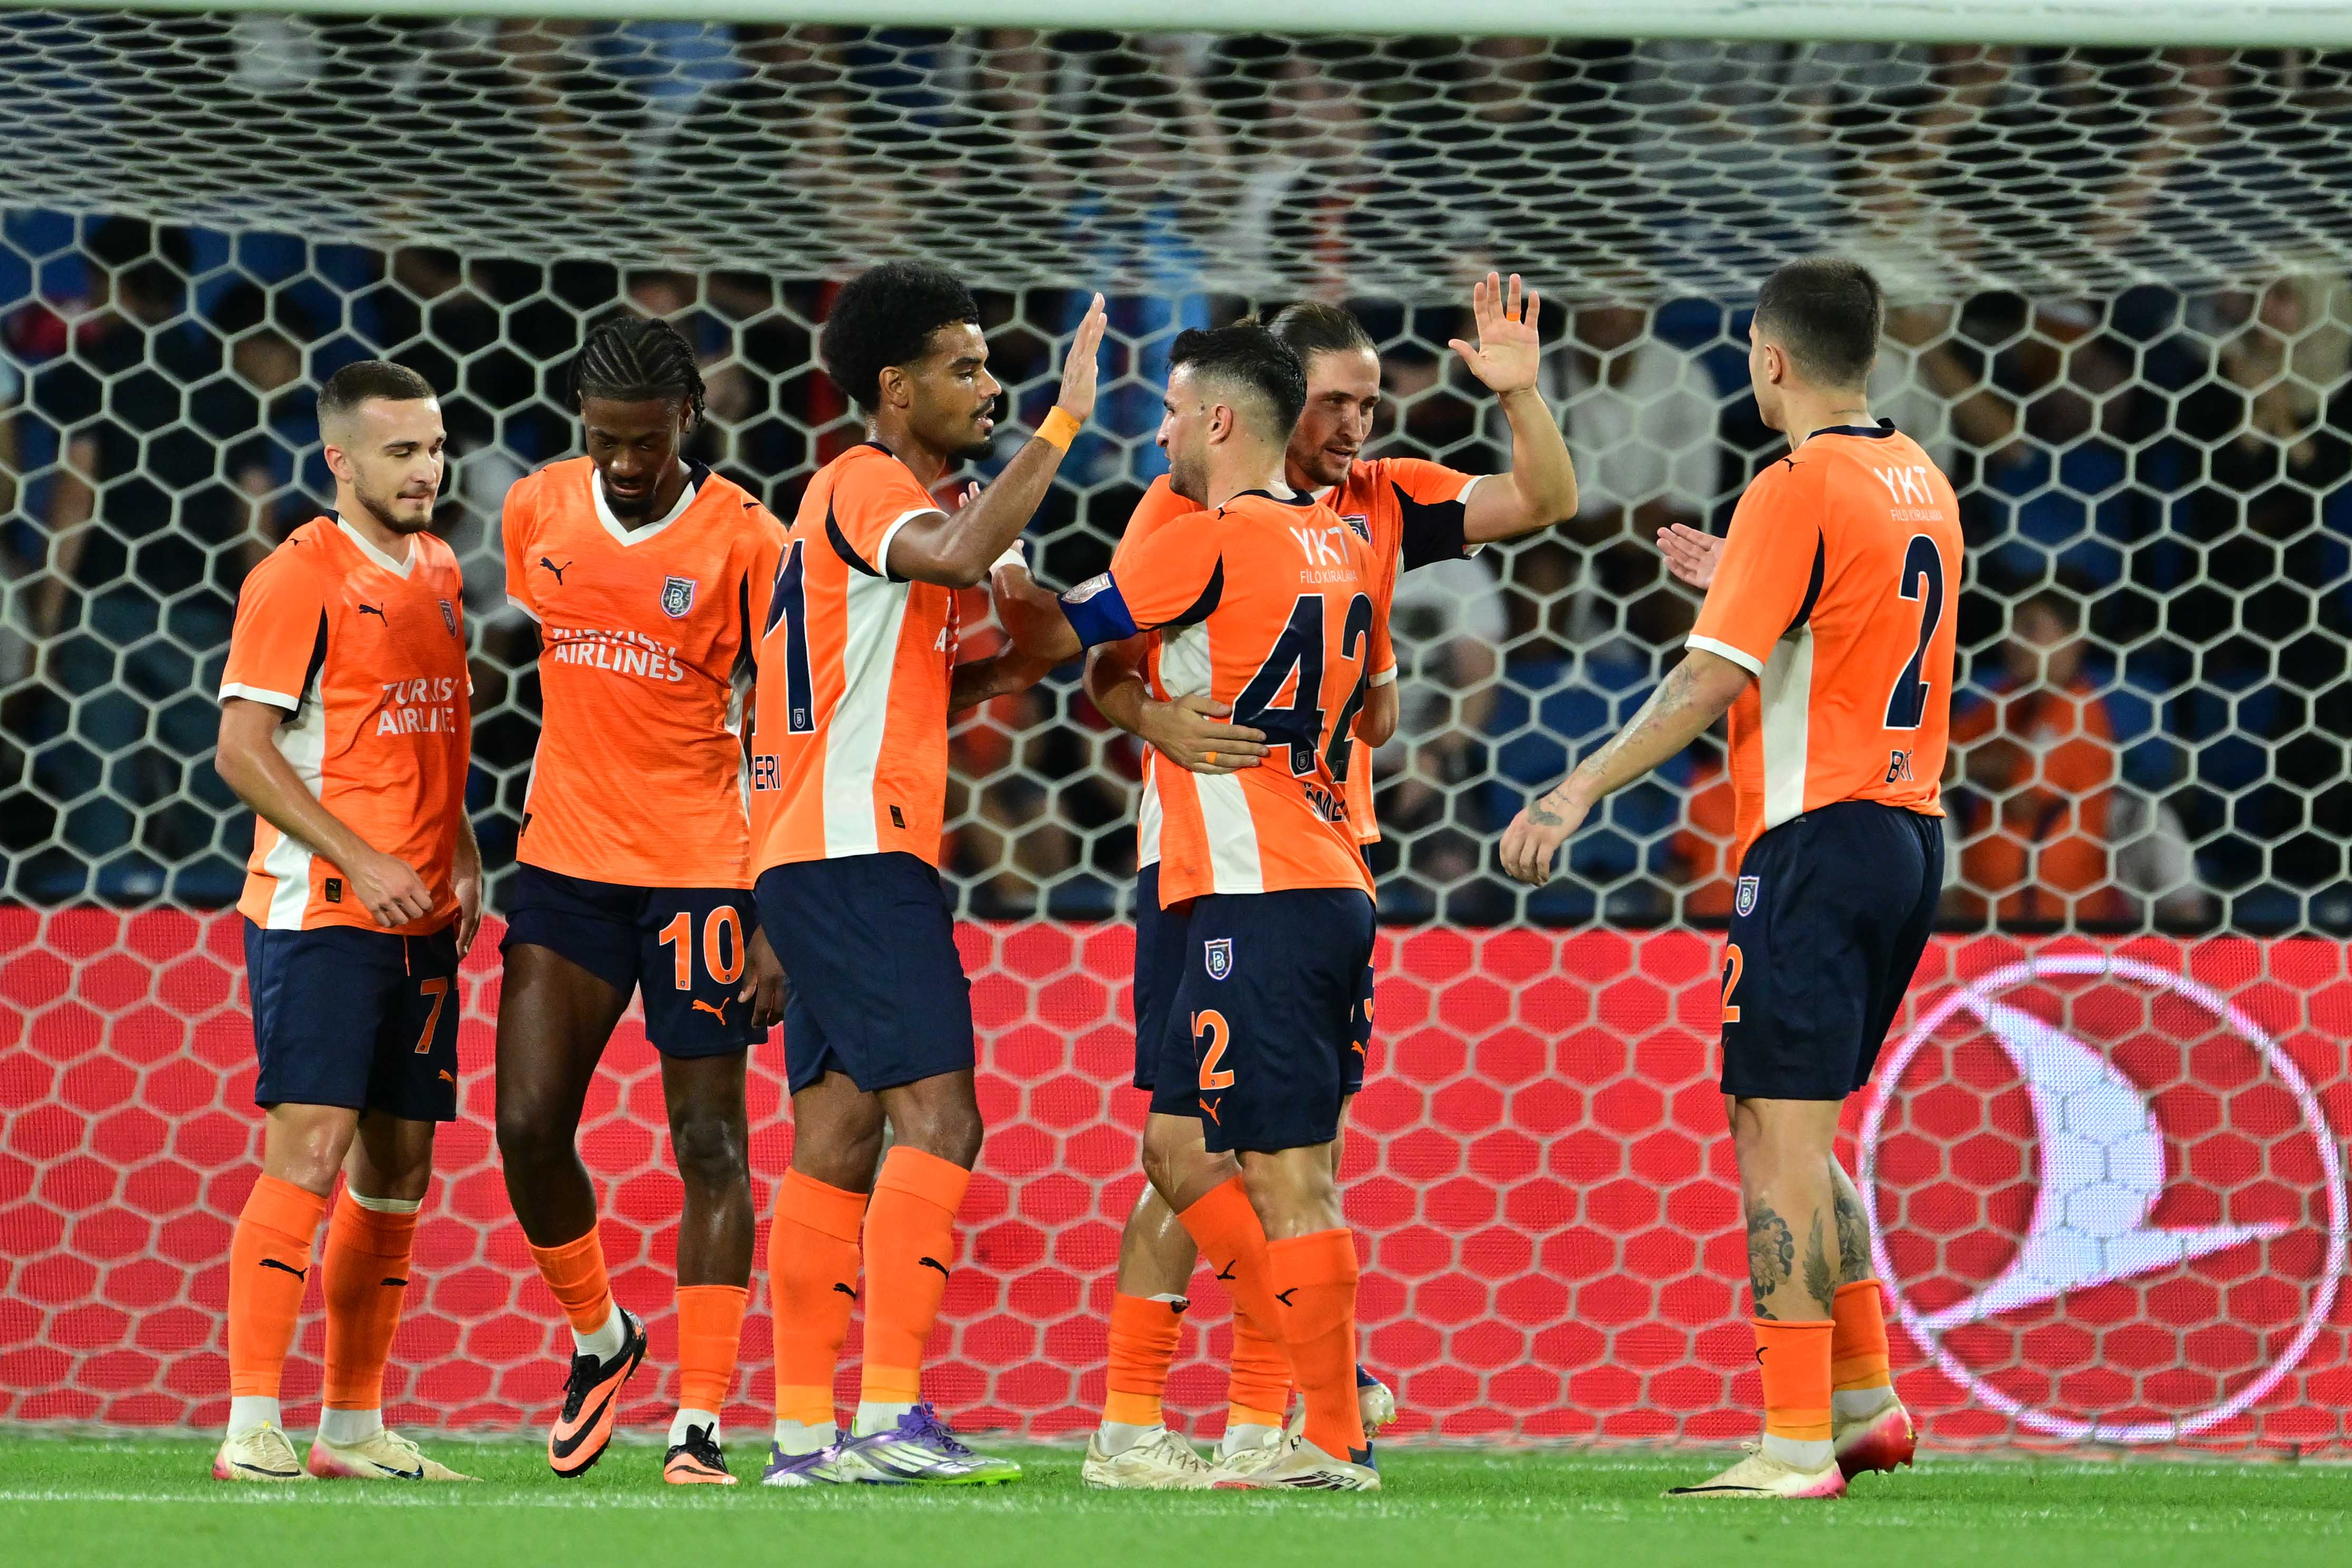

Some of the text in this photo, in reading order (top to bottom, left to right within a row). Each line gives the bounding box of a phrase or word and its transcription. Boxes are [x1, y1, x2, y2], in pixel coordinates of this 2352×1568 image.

[1873, 465, 1933, 504] YKT
[1289, 527, 1349, 566] YKT
[554, 642, 684, 682] AIRLINES
[752, 538, 816, 735] 1
[1883, 533, 1944, 731] 2
[1232, 593, 1374, 784] 42
[751, 754, 781, 791] ERI
[659, 905, 745, 991] 10
[1722, 943, 1743, 1023] 2
[414, 977, 458, 1054] 7
[1191, 1009, 1235, 1090] 2
